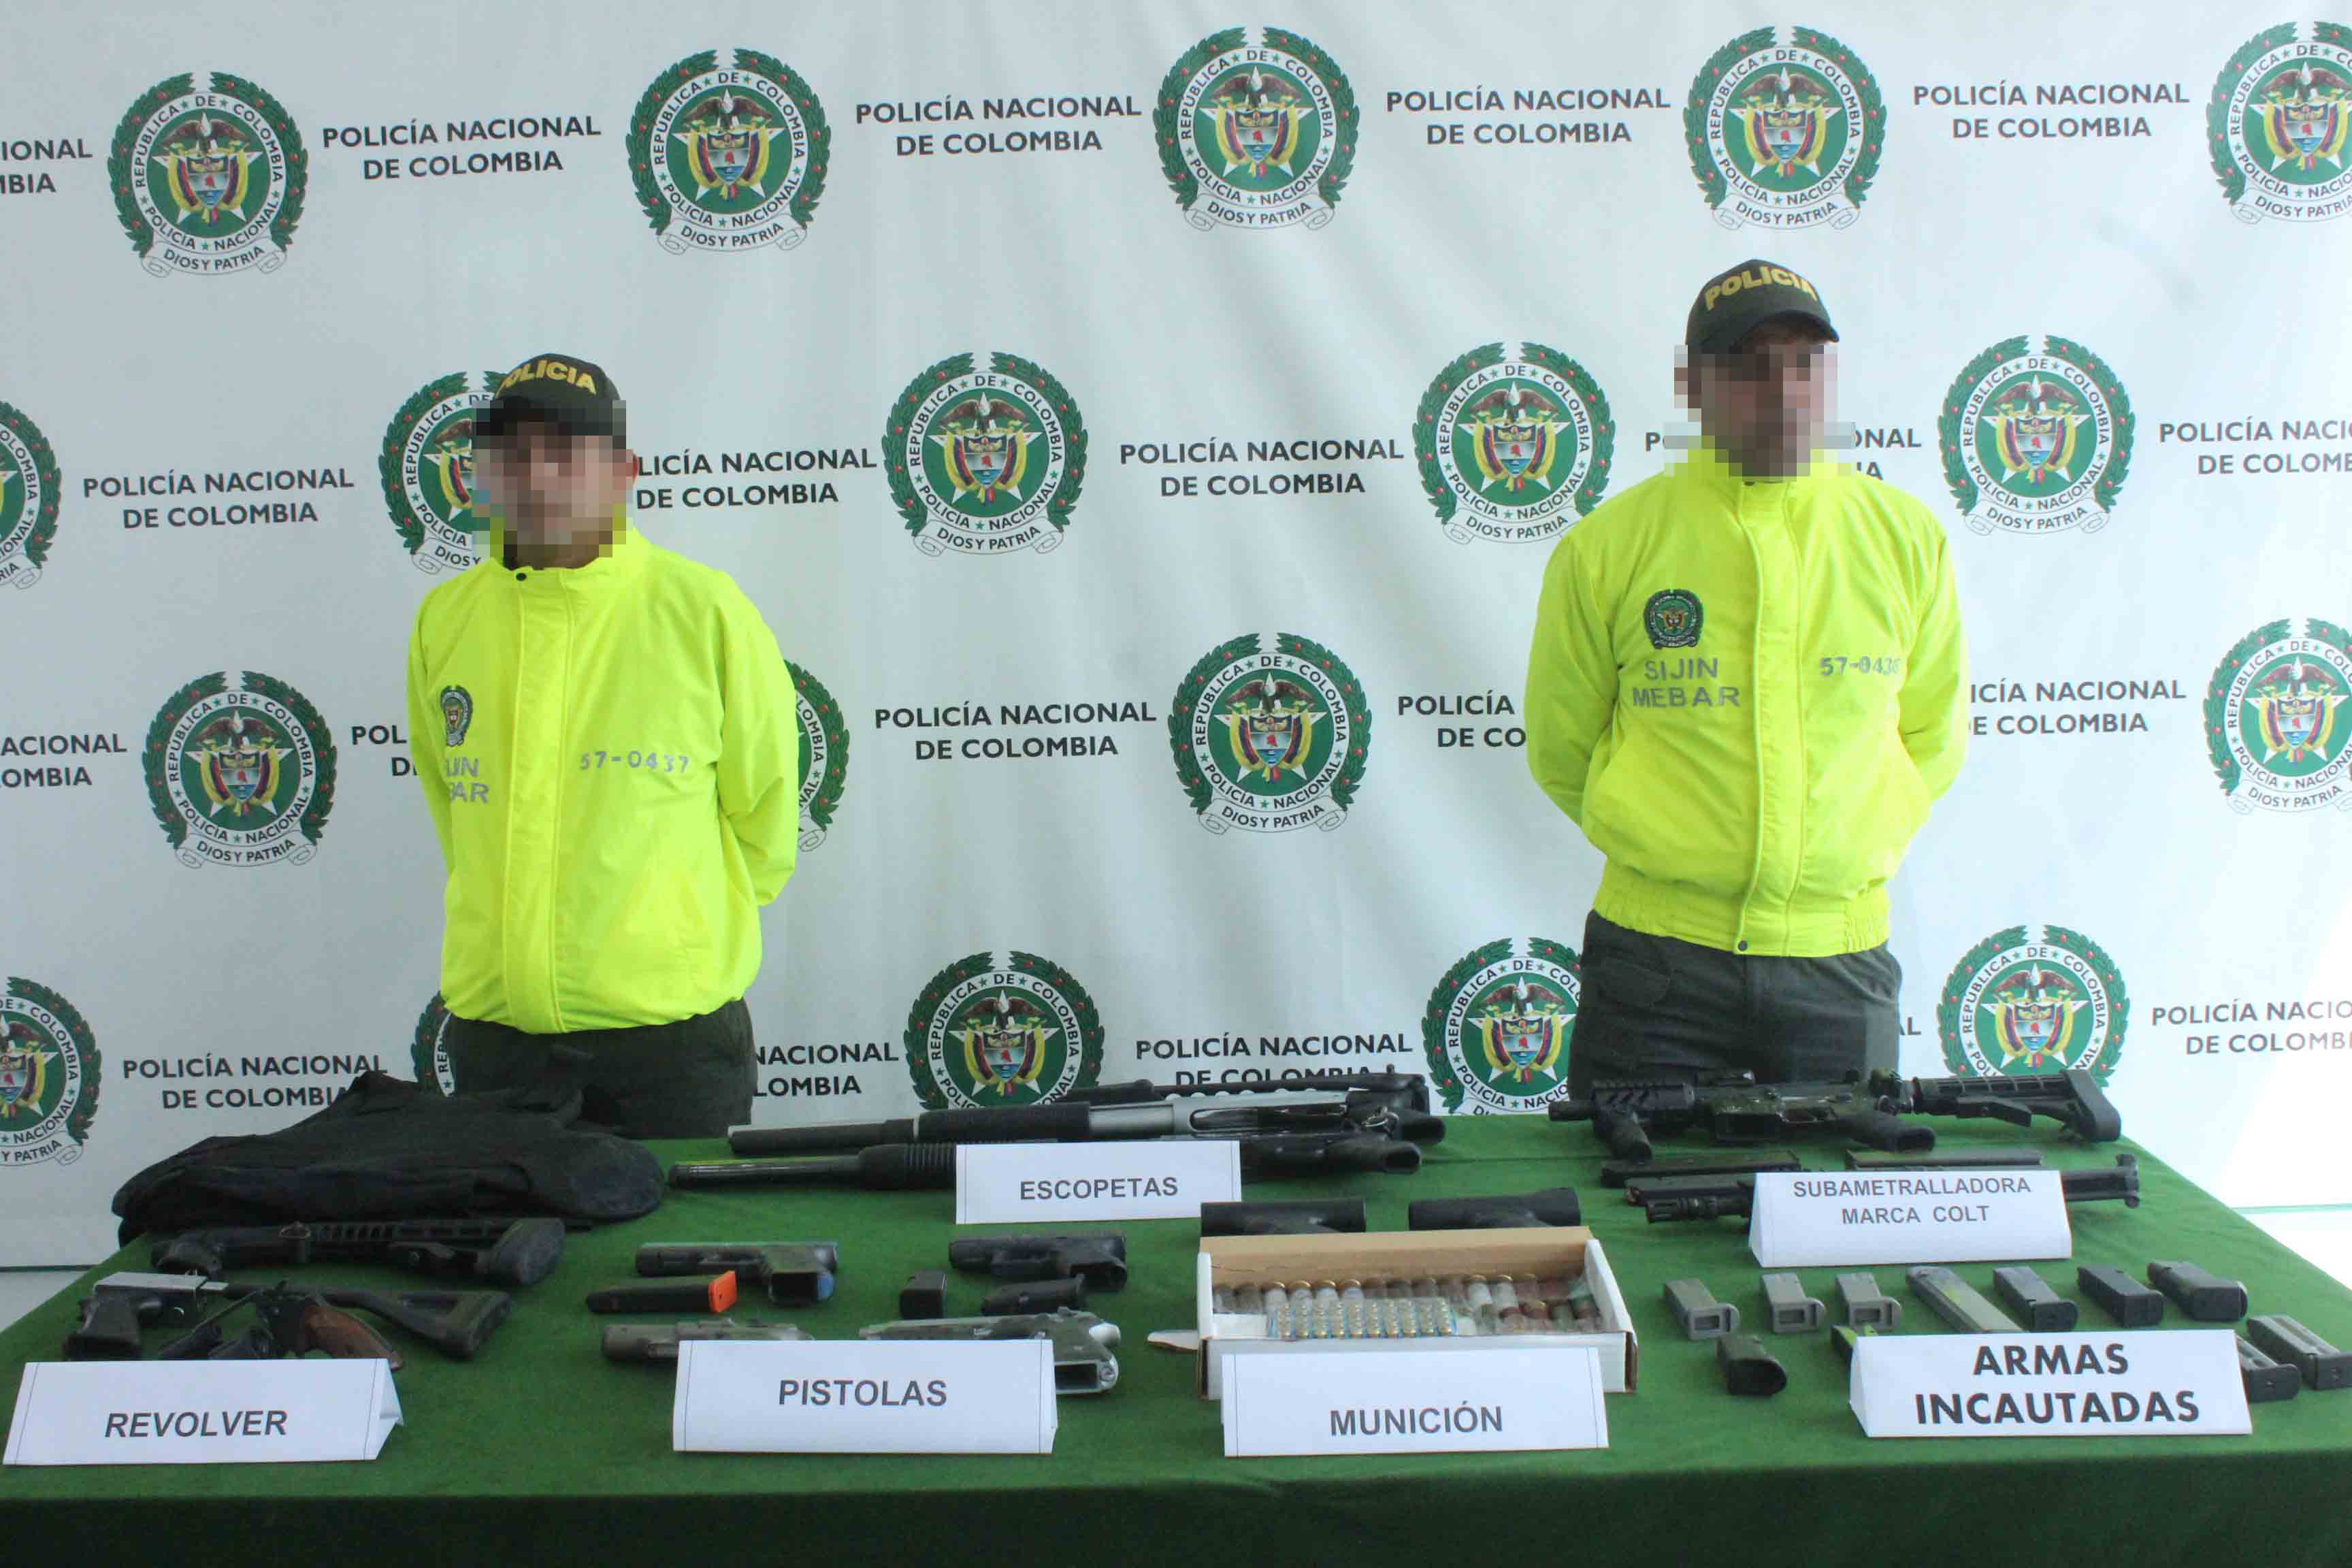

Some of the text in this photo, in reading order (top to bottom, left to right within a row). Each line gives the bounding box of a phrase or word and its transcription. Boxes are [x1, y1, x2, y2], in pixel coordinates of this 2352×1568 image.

[2298, 45, 2319, 55] DE
[1247, 50, 1268, 61] DE
[1286, 59, 1333, 139] COLOMBIA
[1387, 85, 1671, 112] POLICÍA NACIONAL
[1776, 50, 1797, 61] DE
[1814, 59, 1860, 138] COLOMBIA
[1914, 80, 2189, 105] POLICÍA NACIONAL
[718, 73, 739, 84] DE
[757, 80, 804, 159] COLOMBIA
[856, 95, 1142, 124] POLICÍA NACIONAL
[195, 96, 216, 107] DE
[234, 103, 283, 182] COLOMBIA
[323, 116, 601, 148] POLICÍA NACIONAL
[1427, 122, 1631, 144] DE COLOMBIA
[1953, 117, 2151, 138] DE COLOMBIA
[897, 131, 1102, 156] DE COLOMBIA
[363, 151, 564, 180] DE COLOMBIA
[1260, 158, 1327, 205] NACIONAL
[1788, 158, 1854, 205] NACIONAL
[733, 178, 798, 227] NACIONAL
[1260, 202, 1311, 225] PATRIA
[1787, 202, 1838, 225] PATRIA
[214, 201, 278, 250] NACIONAL
[733, 223, 783, 246] PATRIA
[215, 246, 264, 270] PATRIA
[1505, 365, 1526, 376] DE
[1544, 374, 1590, 453] COLOMBIA
[2028, 359, 2048, 369] DE
[2065, 367, 2110, 444] COLOMBIA
[975, 376, 996, 387] DE
[1014, 384, 1062, 462] COLOMBIA
[2160, 416, 2273, 442] POLICÍA
[638, 448, 877, 476] LICÍA NACIONAL
[1120, 437, 1404, 464] POLICÍA NACIONAL
[2198, 453, 2352, 474] DE COLOMB
[84, 468, 354, 498] POLICÍA NACIONAL
[637, 483, 838, 509] DE COLOMBIA
[1161, 473, 1365, 496] DE COLOMBIA
[1518, 472, 1584, 519] NACIONAL
[2038, 463, 2103, 510] NACIONAL
[123, 502, 318, 528] DE COLOMBIA
[990, 482, 1056, 530] NACIONAL
[2038, 507, 2087, 529] PATRIA
[990, 527, 1041, 549] PATRIA
[1518, 516, 1567, 538] PATRIA
[2290, 641, 2310, 651] DE
[1644, 657, 1718, 681] SIJIN
[1261, 657, 1281, 667] DE
[1299, 664, 1346, 742] COLOMBIA
[1399, 690, 1515, 715] POLICÍA
[1633, 686, 1740, 708] MEBAR
[2036, 680, 2187, 702] NACIONAL
[875, 701, 1157, 728] POLICÍA NACIONAL
[1997, 713, 2148, 735] COLOMBIA
[0, 733, 127, 756] ACIONAL
[228, 694, 248, 704] DE
[265, 702, 313, 778] COLOMBIA
[916, 736, 1118, 760] DE COLOMBIA
[1438, 728, 1474, 747] DE
[1274, 761, 1340, 808] NACIONAL
[2295, 785, 2341, 808] PATRIA
[246, 796, 308, 843] NACIONAL
[1274, 805, 1324, 828] PATRIA
[247, 840, 295, 862] PATRIA
[1514, 961, 1534, 971] DE
[2027, 947, 2106, 1029] DE COLOMBIA
[994, 974, 1079, 1057] DE COLOMBIA
[2152, 999, 2352, 1026] POLICÍA NACIO
[31, 1007, 78, 1080] COLOMBIA
[757, 1043, 898, 1064] NACIONAL
[1137, 1032, 1412, 1060] POLICÍA NACIONAL
[2187, 1035, 2219, 1055] DE
[123, 1053, 388, 1079] POLICÍA NACIONAL
[162, 1085, 347, 1109] DE COLOMBI
[14, 1098, 74, 1143] NACIONAL
[15, 1140, 61, 1162] PATRIA
[1021, 1177, 1177, 1200] ESCOPETAS
[1794, 1177, 2031, 1197] SUBAMETRALLADORA
[1842, 1205, 1989, 1224] MARCA COLT
[1973, 1343, 2128, 1375] ARMAS
[779, 1379, 947, 1406] PISTOLAS
[1330, 1401, 1503, 1436] MUNICIÓN
[1916, 1390, 2199, 1424] INCAUTADAS
[105, 1410, 287, 1437] REVOLVER
